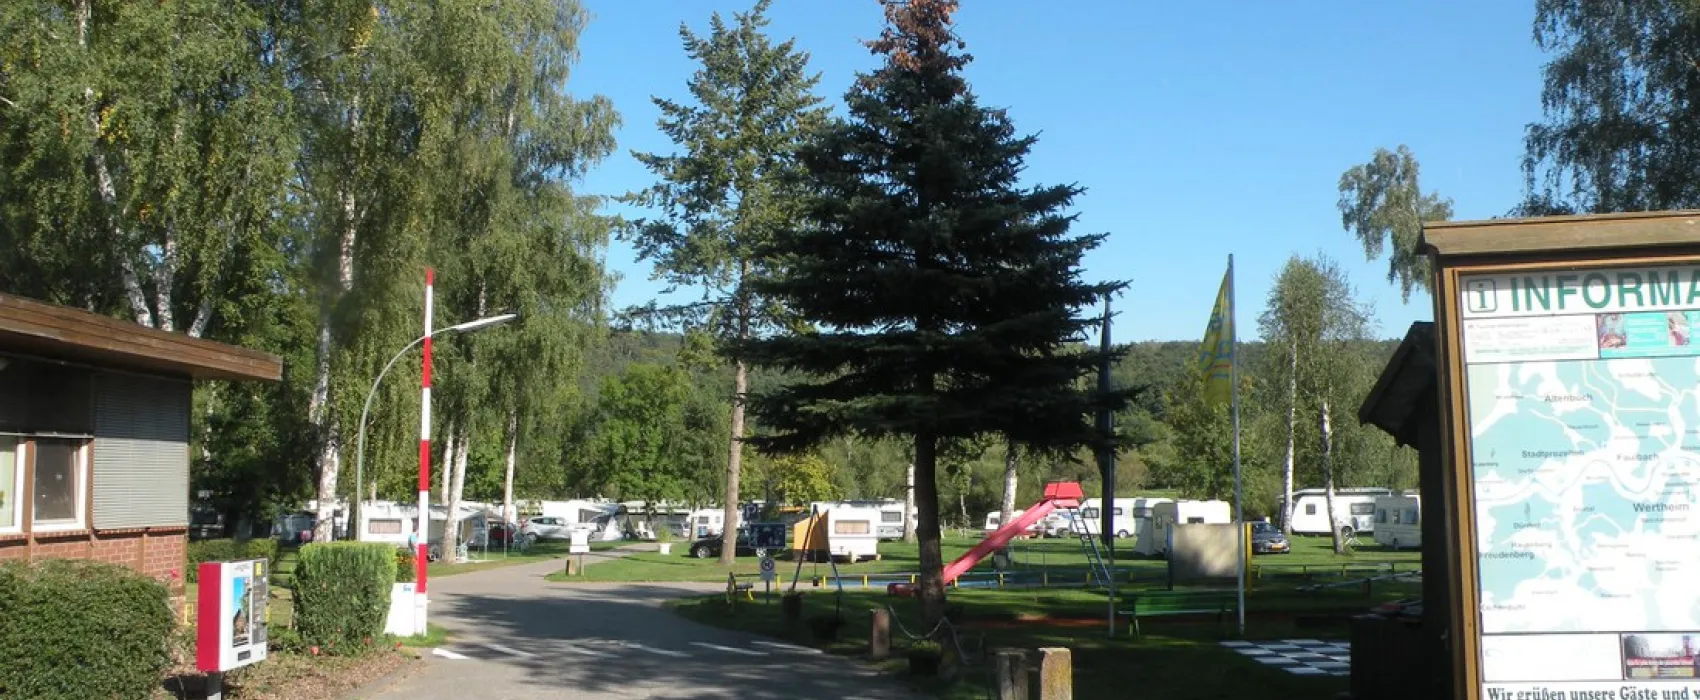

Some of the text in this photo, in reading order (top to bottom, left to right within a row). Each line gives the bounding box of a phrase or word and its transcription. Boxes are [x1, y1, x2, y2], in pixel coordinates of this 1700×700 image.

[1632, 502, 1690, 513] Wertheim
[1487, 687, 1514, 700] Wir
[1569, 689, 1616, 700] unsere
[1619, 686, 1658, 700] Gäste
[1662, 686, 1689, 700] und
